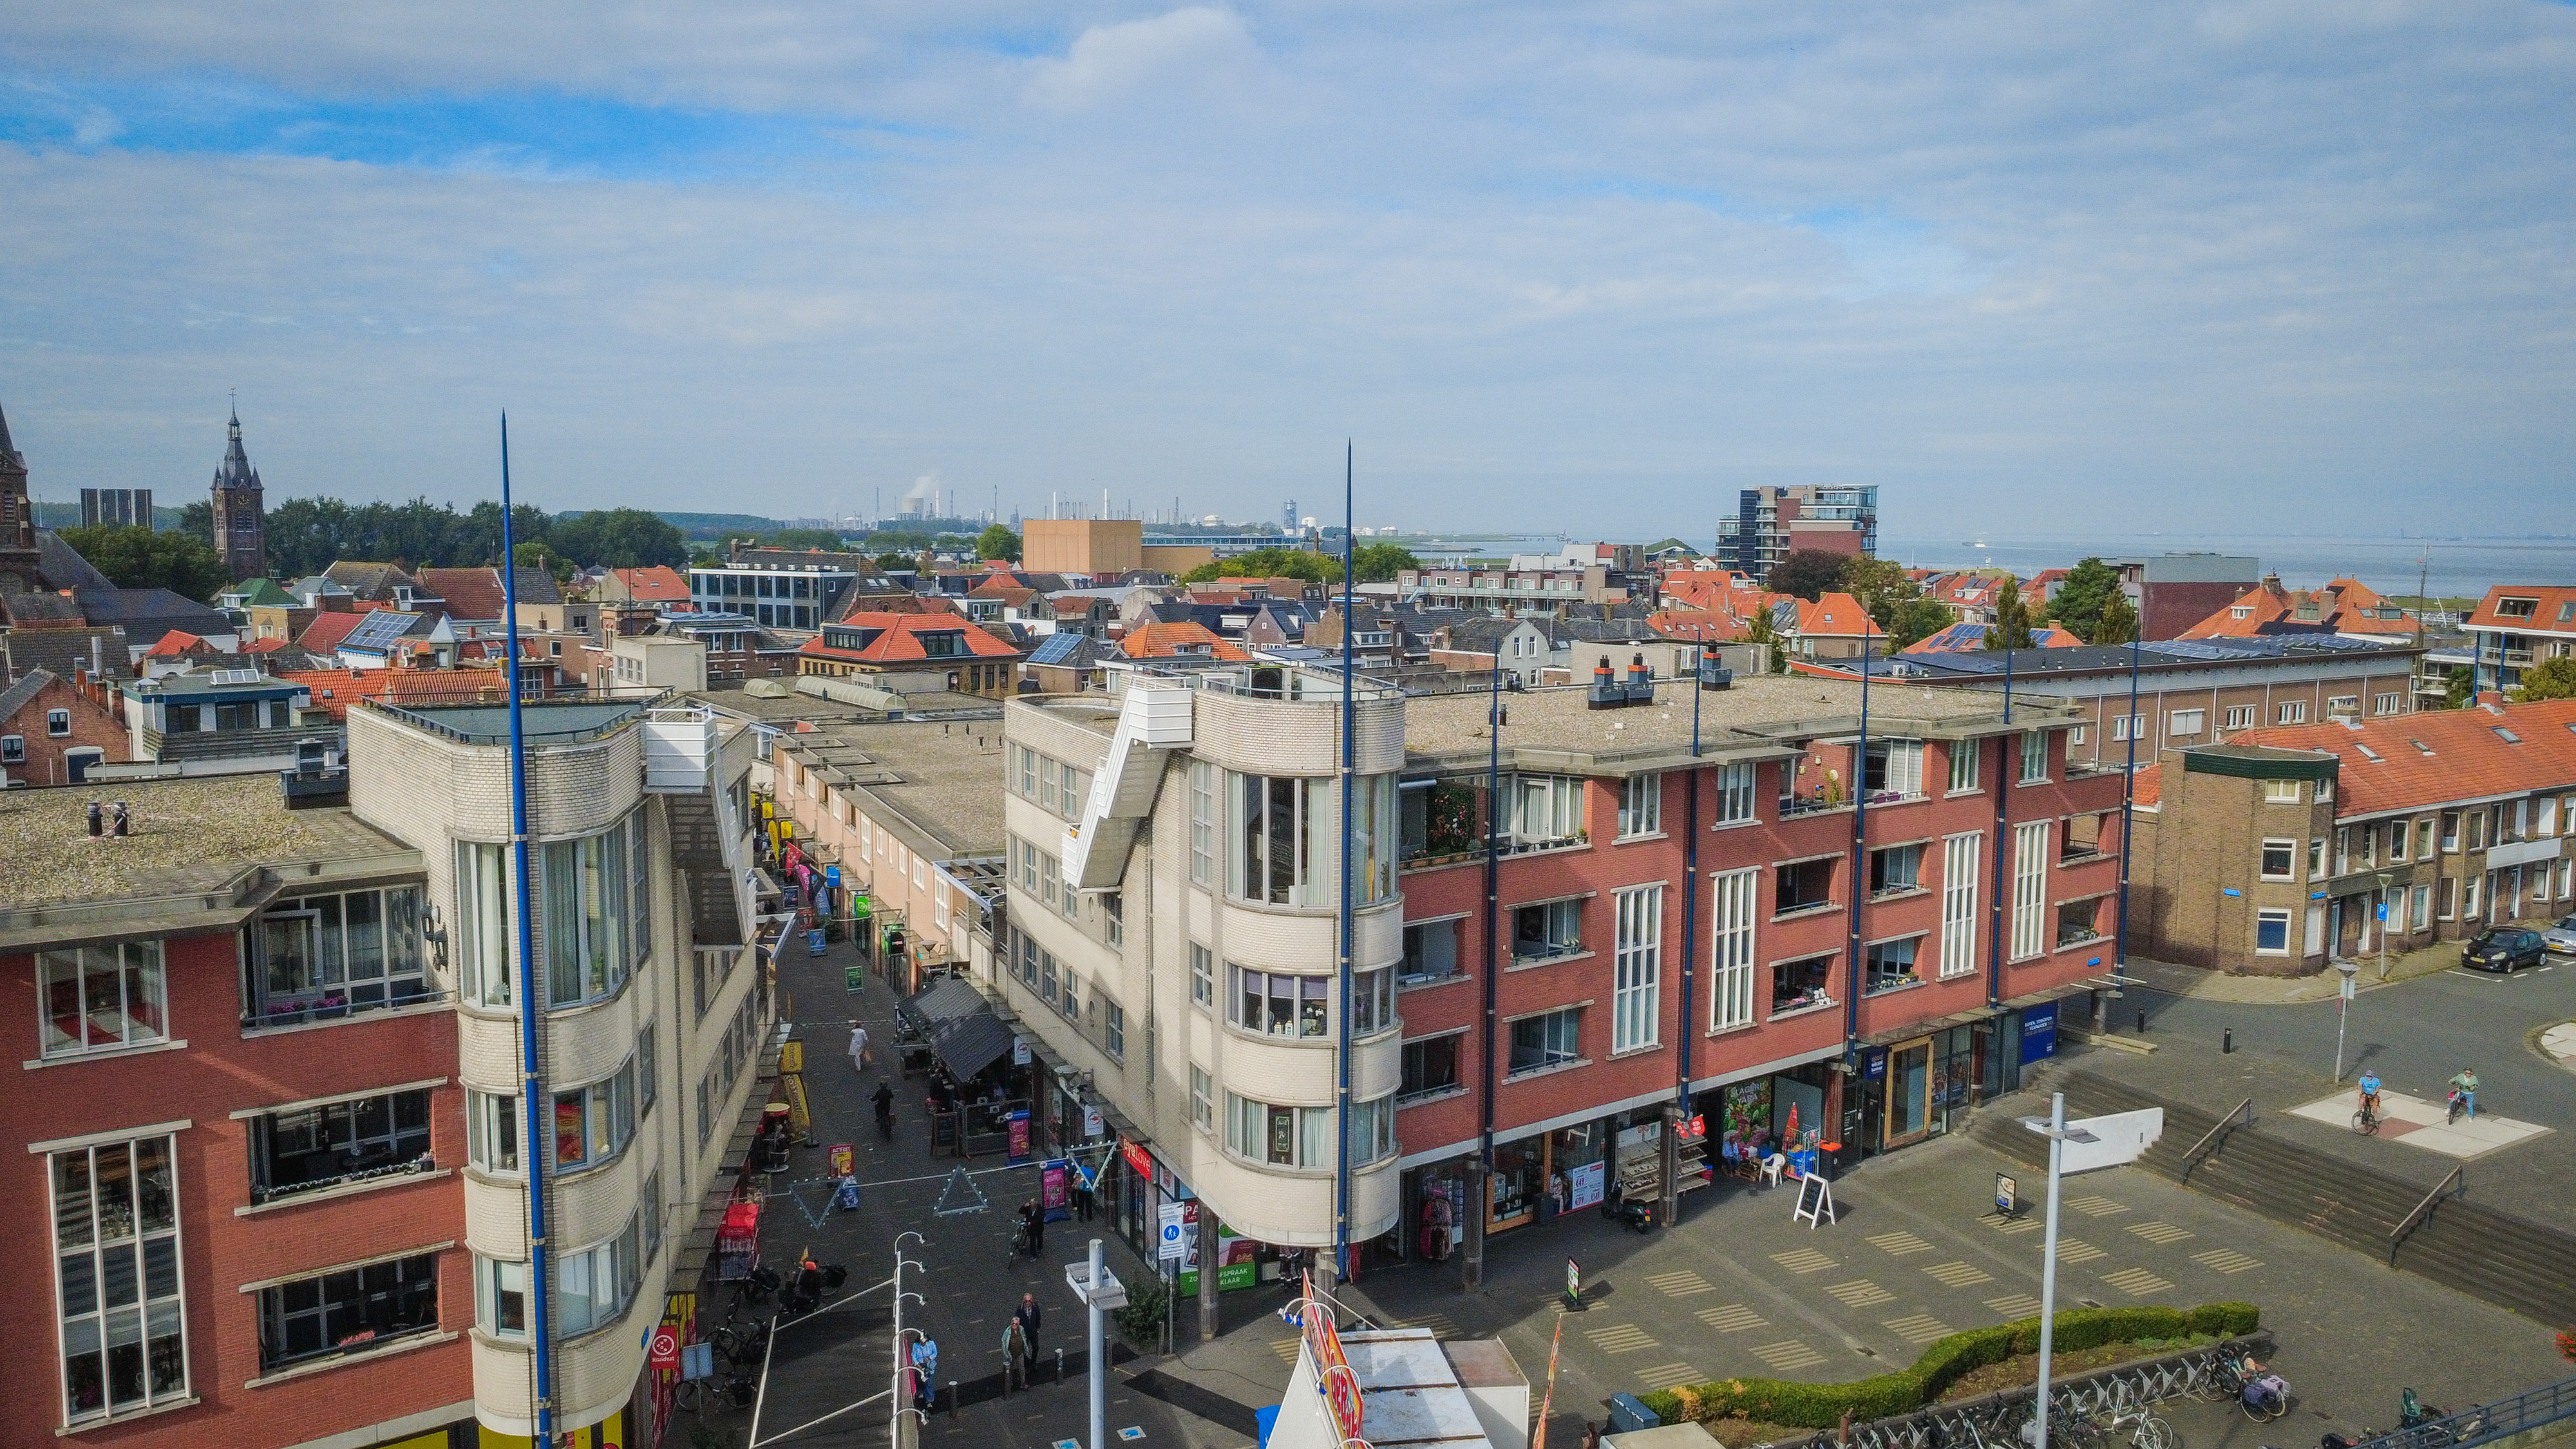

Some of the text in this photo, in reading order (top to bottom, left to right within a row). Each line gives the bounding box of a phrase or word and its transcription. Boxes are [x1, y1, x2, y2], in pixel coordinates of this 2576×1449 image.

[2380, 905, 2385, 914] P
[1218, 1267, 1248, 1277] FSPRAAK
[1220, 1277, 1240, 1285] KLAAR
